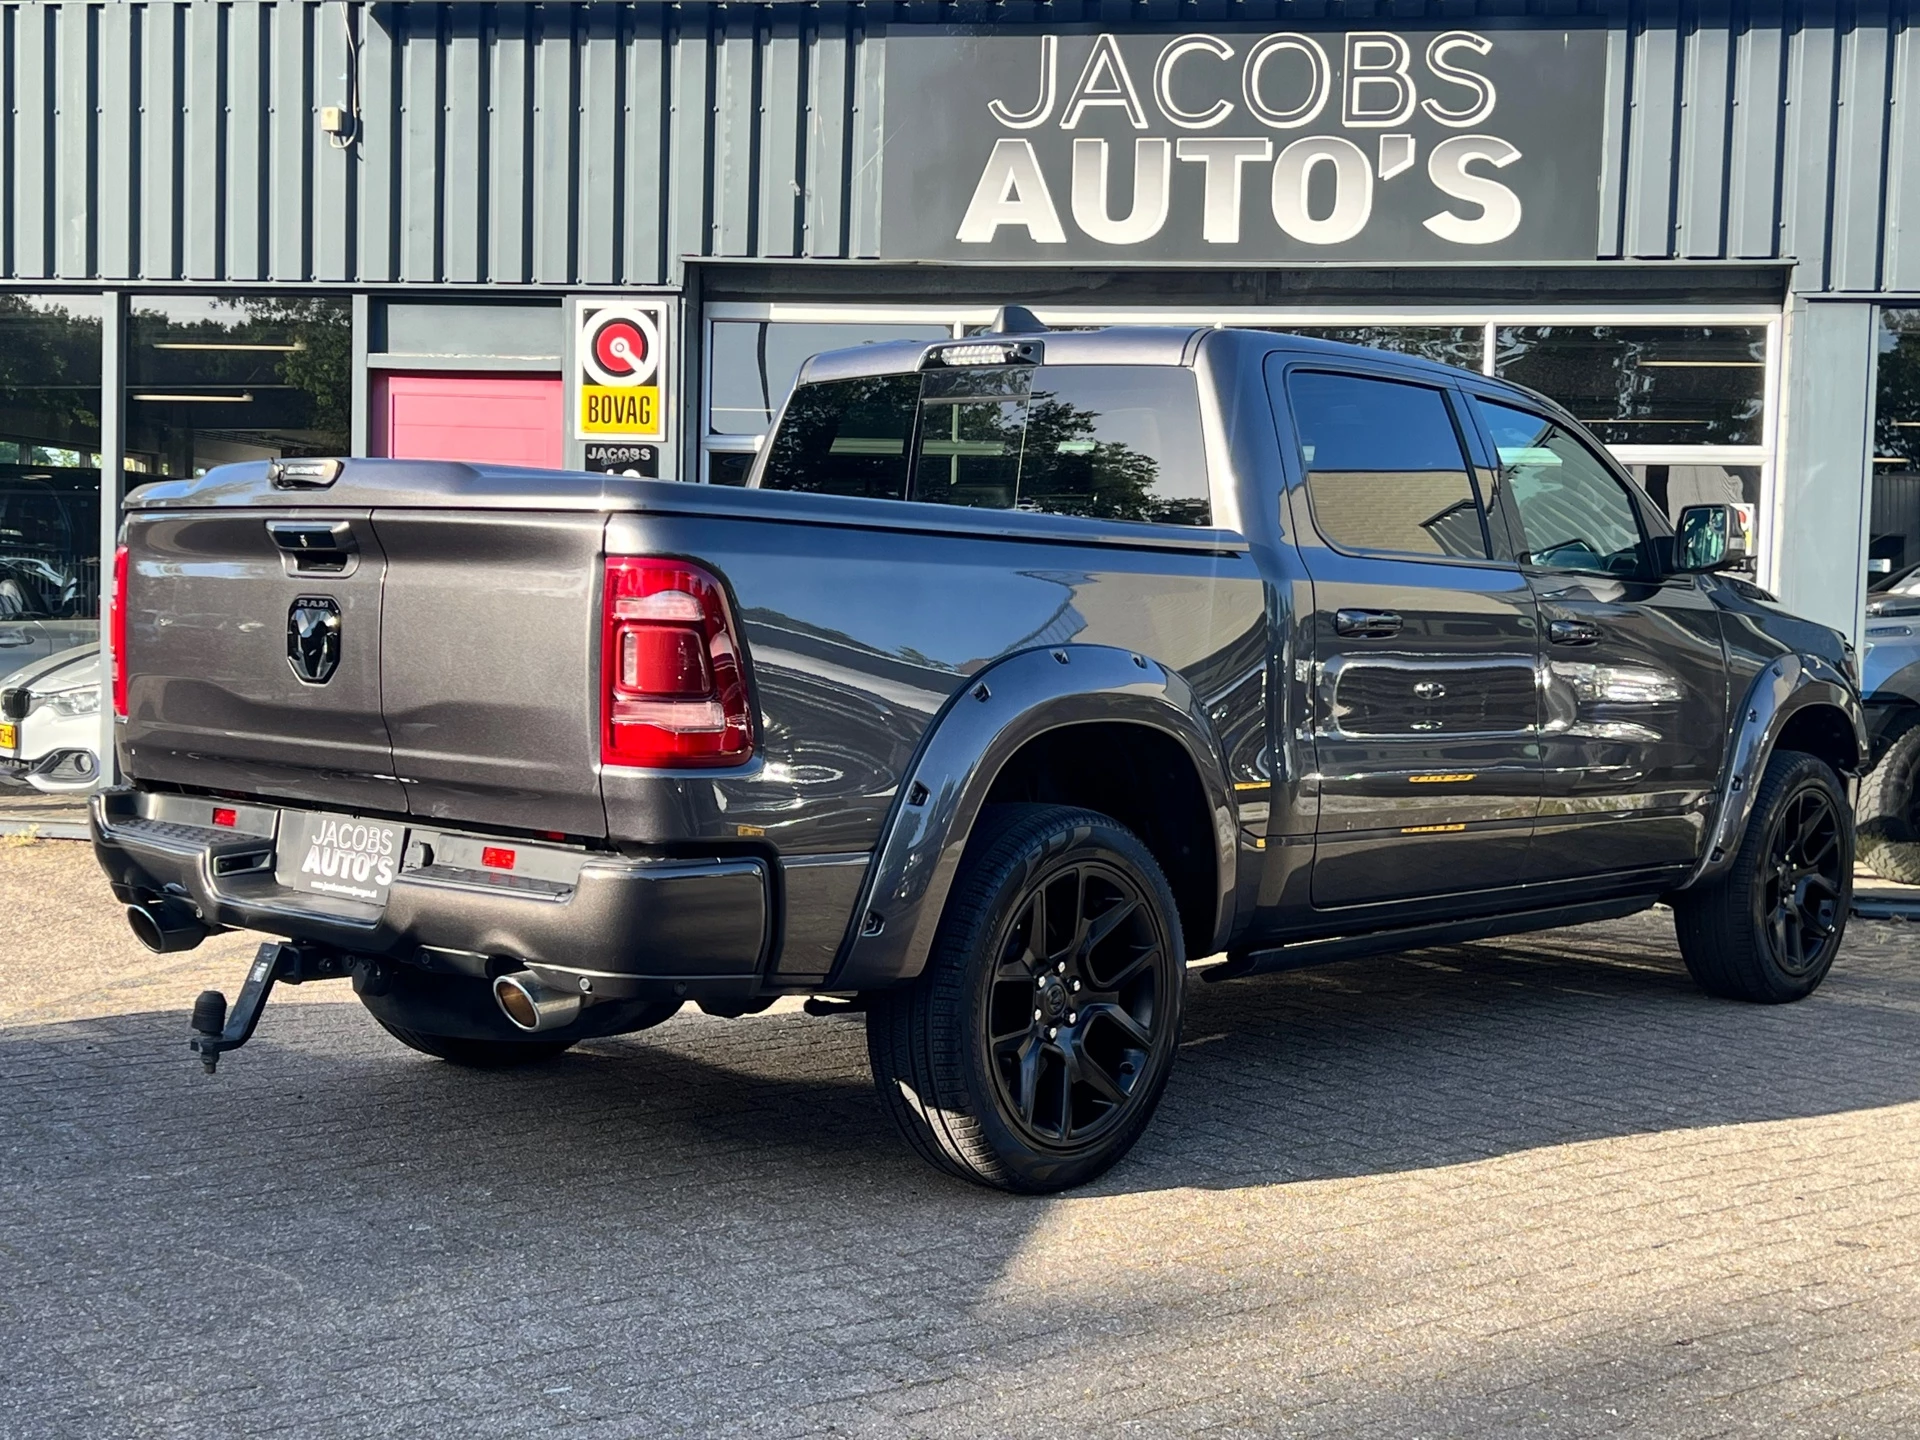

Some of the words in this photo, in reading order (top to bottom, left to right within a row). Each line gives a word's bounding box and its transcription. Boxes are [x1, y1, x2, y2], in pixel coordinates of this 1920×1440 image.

[987, 31, 1497, 130] JACOBS
[955, 134, 1523, 244] AUTO'S
[588, 395, 651, 425] BOVAG
[587, 447, 651, 461] JACOBS
[298, 600, 329, 608] RAM
[312, 820, 394, 855] JACOBS
[301, 845, 394, 886] AUTO'S
